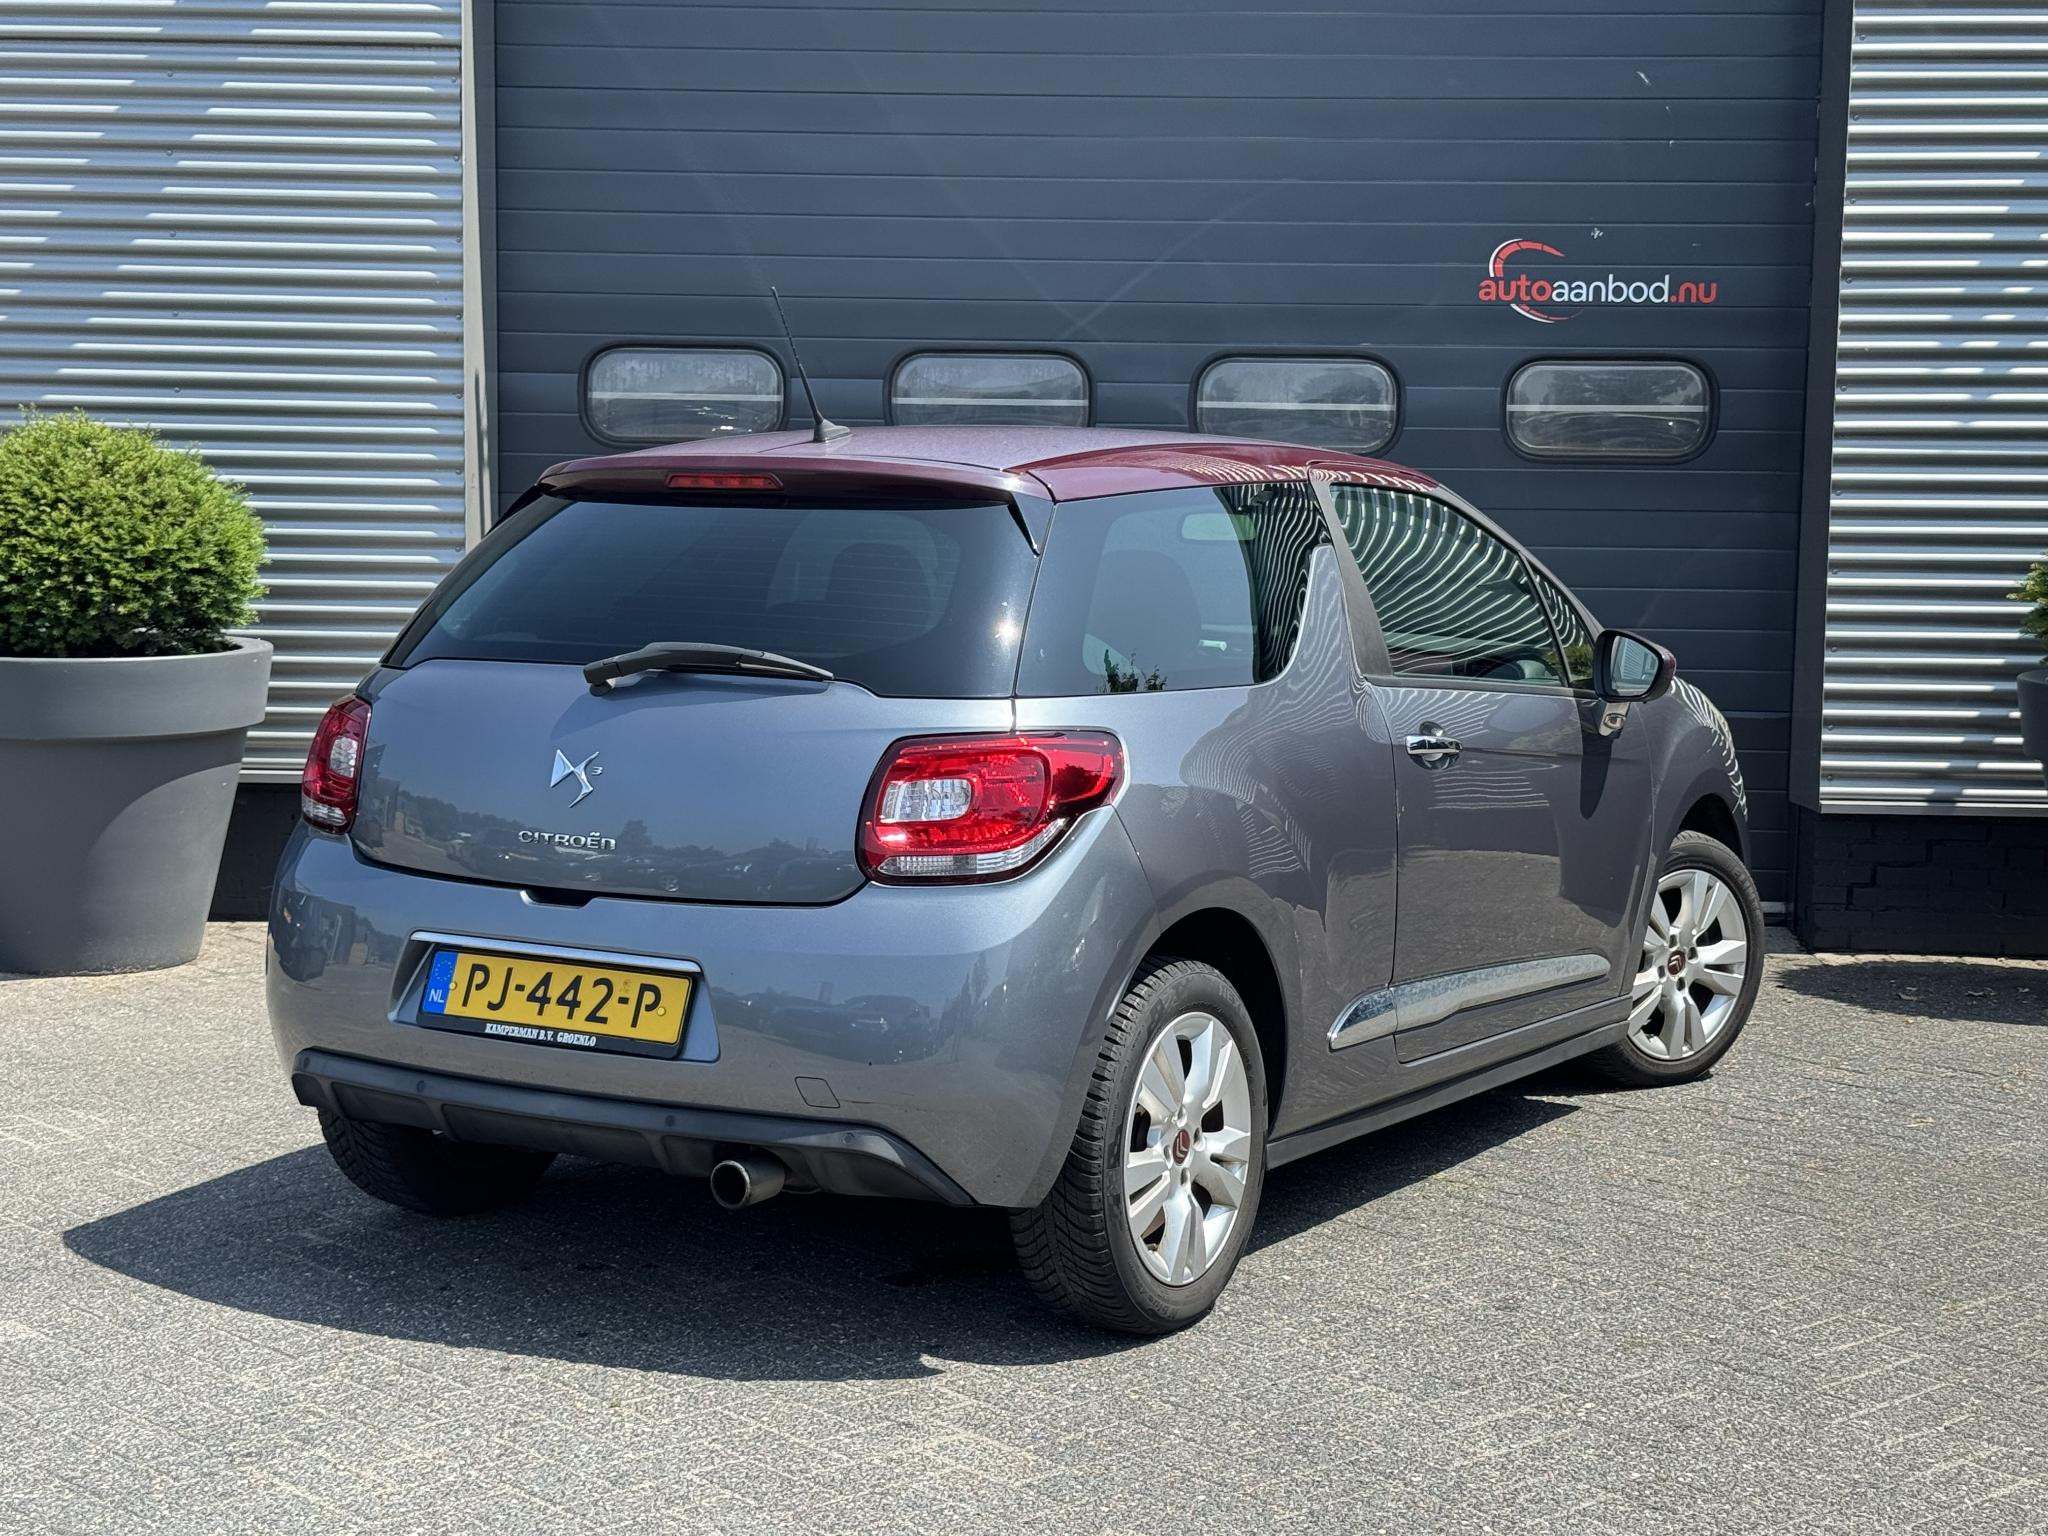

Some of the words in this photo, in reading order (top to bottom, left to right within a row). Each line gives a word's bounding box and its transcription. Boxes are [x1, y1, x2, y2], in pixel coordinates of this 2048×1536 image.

[1478, 274, 1718, 303] autoaanbod.nu
[428, 988, 445, 1004] NL
[461, 962, 662, 1029] PJ-442-P
[485, 1023, 538, 1039] KAMPERMAN
[538, 1029, 554, 1041] B.V.
[556, 1031, 597, 1047] GROENLO
